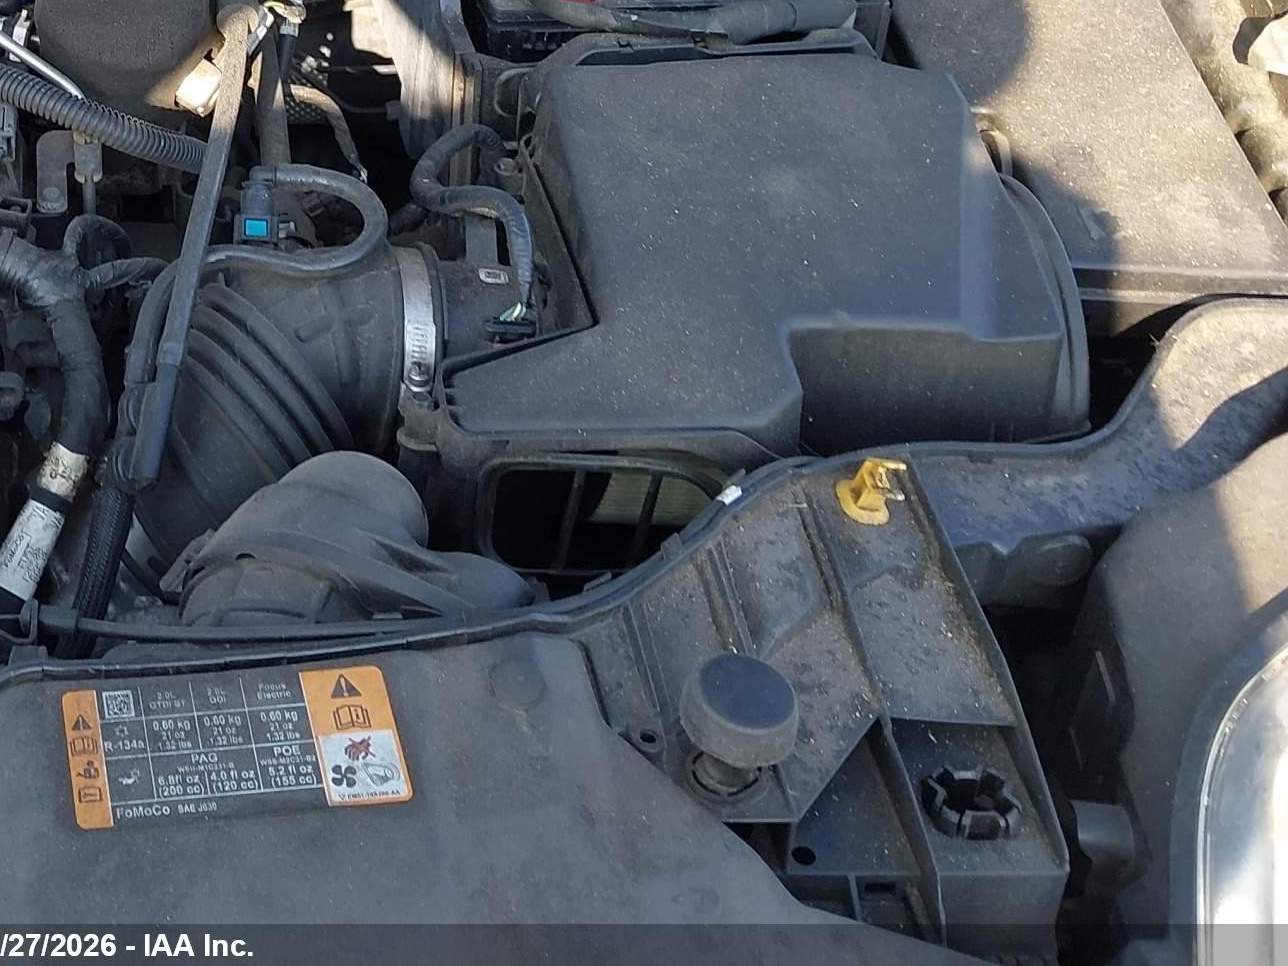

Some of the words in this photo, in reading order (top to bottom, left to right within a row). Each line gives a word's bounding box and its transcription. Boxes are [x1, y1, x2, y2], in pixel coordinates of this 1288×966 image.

[257, 690, 292, 700] Electric
[203, 715, 226, 727] 0.60
[228, 715, 242, 727] kg
[260, 710, 283, 722] 0.60
[284, 710, 298, 722] kg
[153, 720, 175, 731] 0.60
[177, 720, 191, 731] kg
[213, 726, 224, 735] 21
[270, 723, 280, 731] 21
[161, 732, 173, 741] 21
[229, 735, 243, 744] lbs
[267, 731, 285, 741] 1.32
[287, 731, 301, 739] lbs
[103, 739, 145, 753] R-134a
[178, 741, 192, 749] lbs
[273, 745, 301, 757] POE
[191, 753, 219, 764] PAG
[210, 771, 228, 781] 4.0
[242, 770, 256, 779] oz
[268, 766, 286, 777] 5.2
[299, 765, 314, 774] oz
[186, 774, 201, 783] oz
[298, 774, 317, 786] cc)
[158, 785, 184, 799] (200
[186, 782, 205, 796] cc)
[213, 781, 237, 795] (120
[240, 778, 259, 791] cc)
[116, 804, 171, 819] FoMoCo
